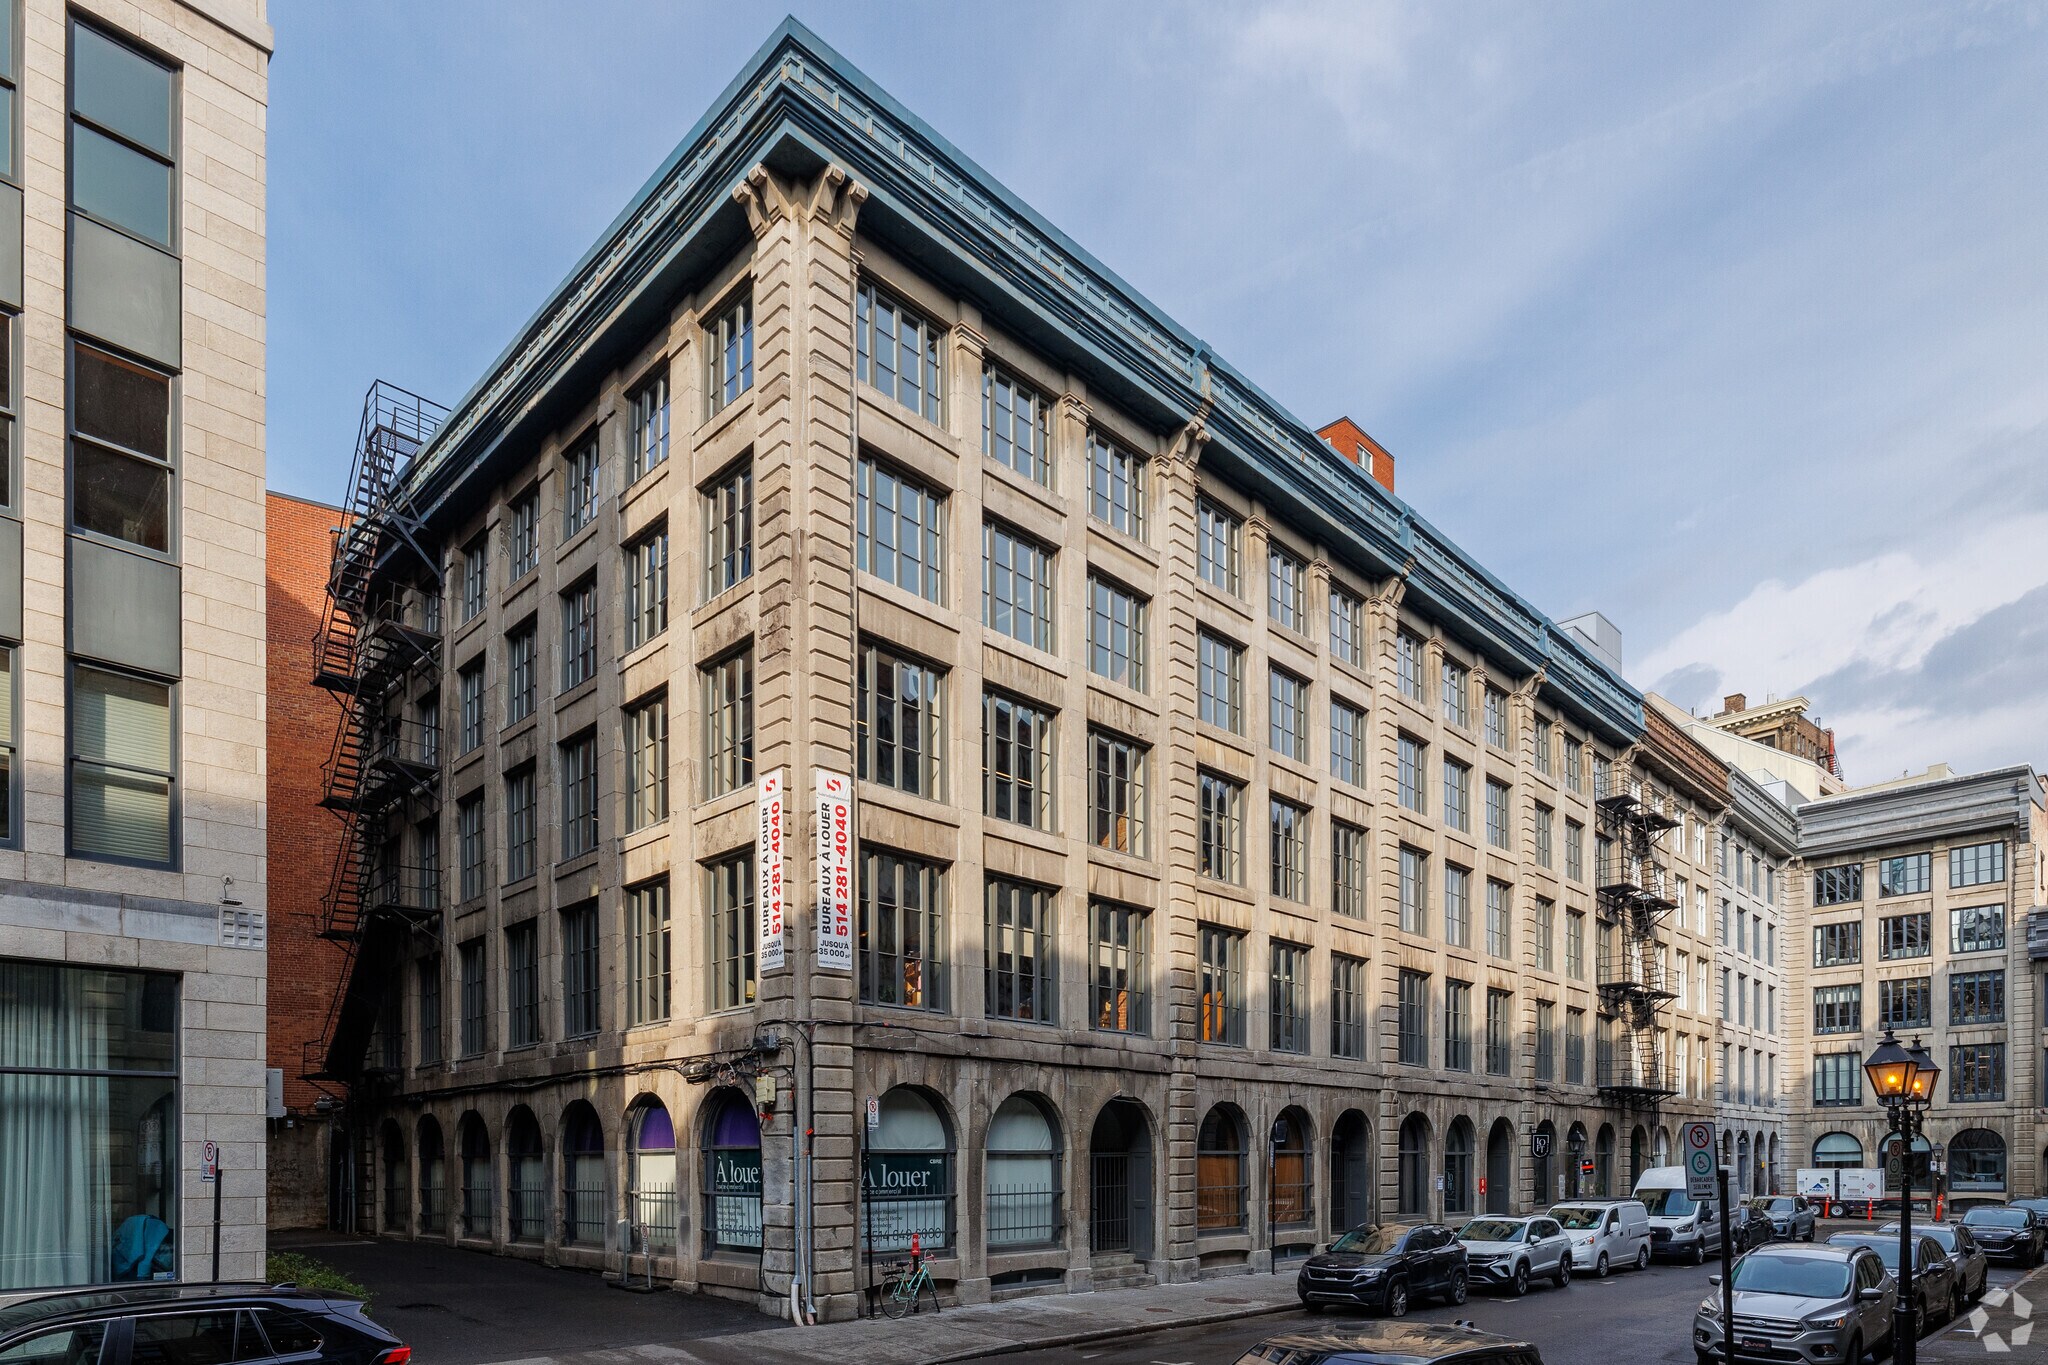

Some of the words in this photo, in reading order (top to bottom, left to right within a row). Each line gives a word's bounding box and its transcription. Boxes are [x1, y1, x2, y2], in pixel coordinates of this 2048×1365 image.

[822, 803, 831, 852] LOUER
[761, 853, 769, 864] À
[771, 801, 781, 898] 281-4040
[819, 852, 831, 862] À
[835, 804, 847, 900] 281-4040
[762, 868, 770, 937] BUREAUX
[822, 864, 831, 934] BUREAUX
[772, 900, 781, 935] 514
[836, 903, 848, 937] 514
[761, 951, 768, 959] 35
[768, 949, 779, 958] 000
[762, 938, 781, 950] JUSQU'À
[819, 948, 828, 956] 35
[829, 949, 845, 958] 000
[820, 940, 849, 950] JUSQU'À
[716, 1156, 728, 1183] À
[881, 1163, 931, 1188] louer
